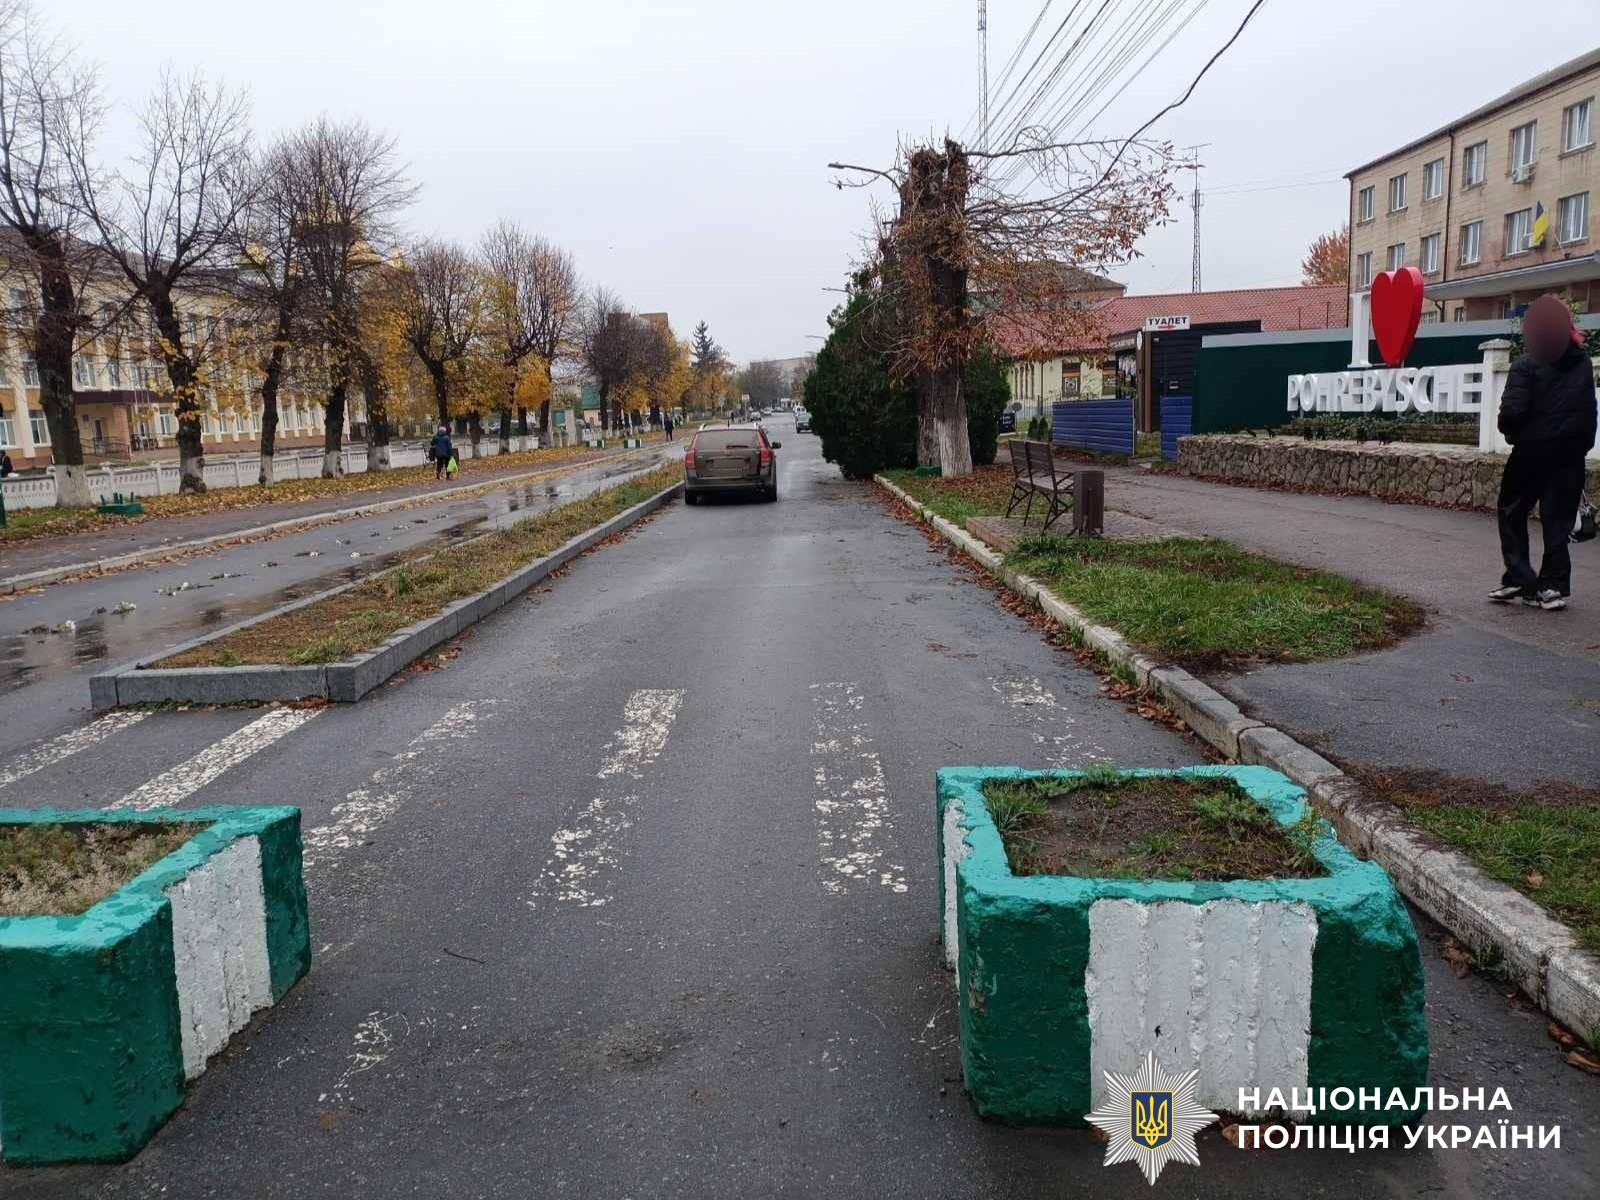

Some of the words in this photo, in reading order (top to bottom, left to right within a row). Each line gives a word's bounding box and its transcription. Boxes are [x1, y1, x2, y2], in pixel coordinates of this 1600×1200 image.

[1148, 316, 1188, 326] ТУАЛЕТ
[1348, 291, 1372, 368] I
[1287, 363, 1484, 413] POHREBYSCHE
